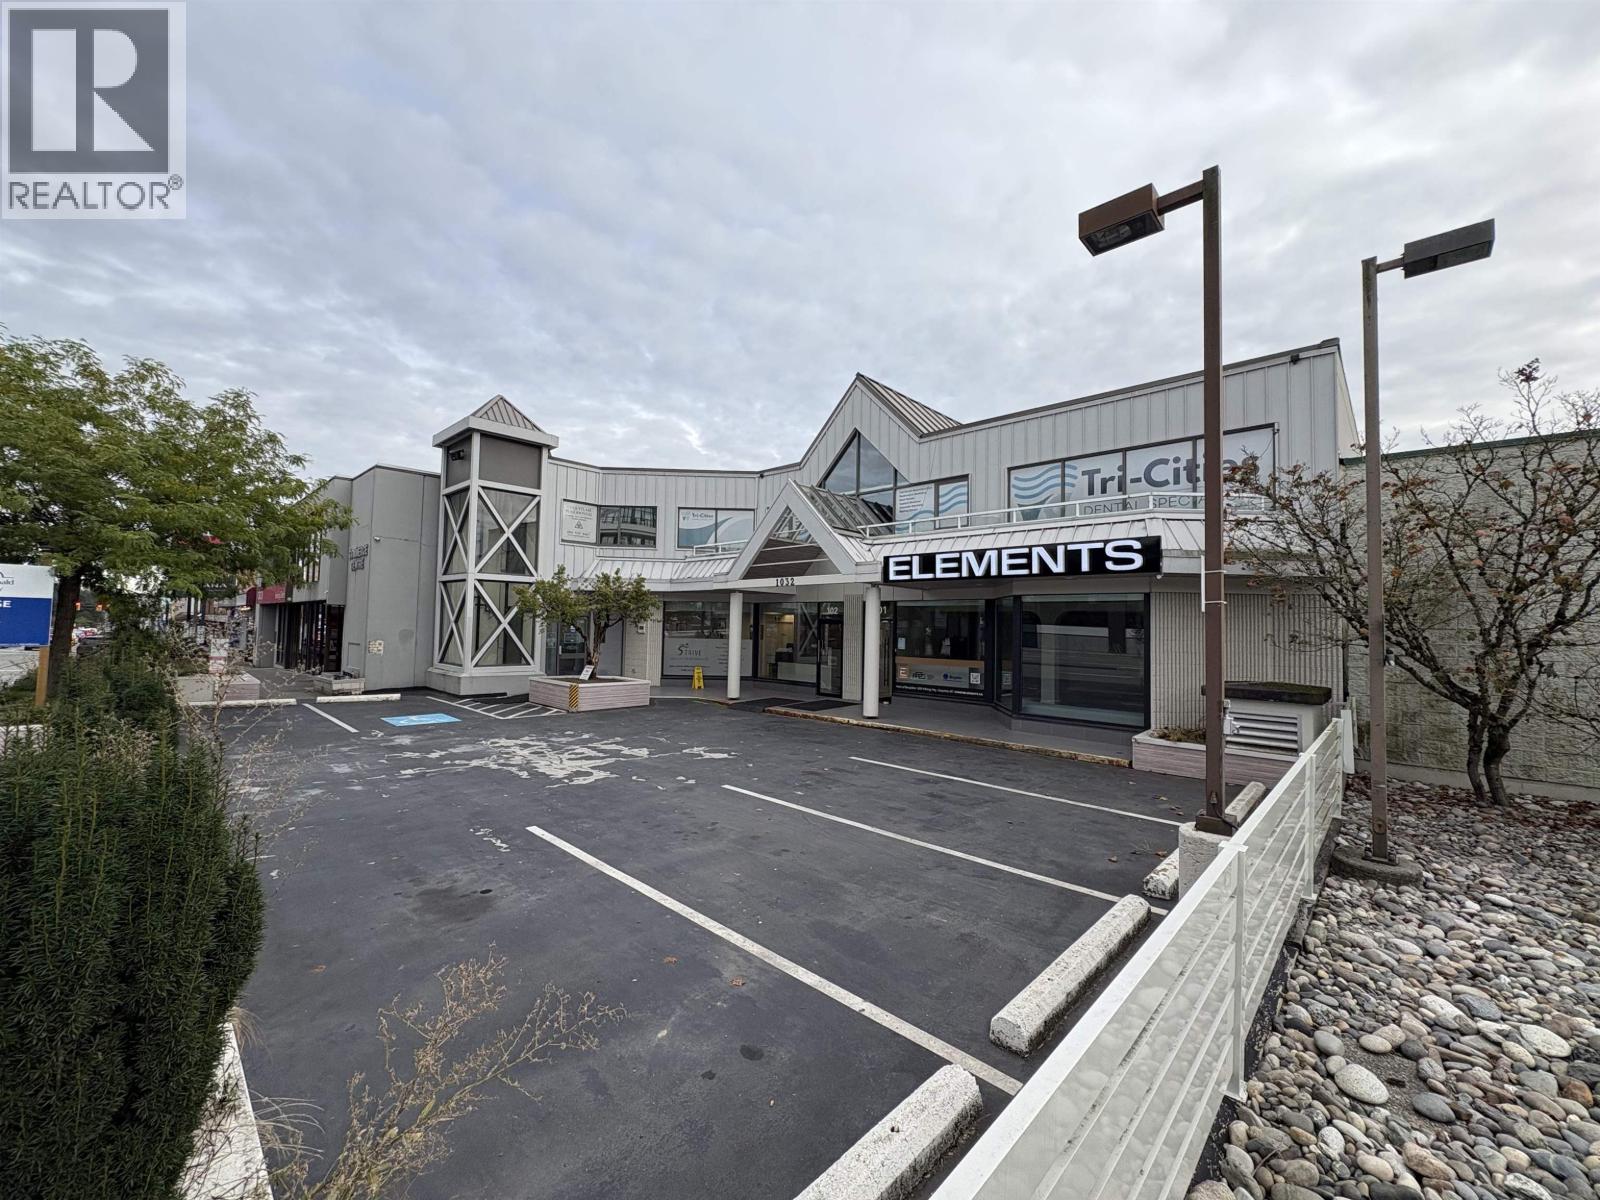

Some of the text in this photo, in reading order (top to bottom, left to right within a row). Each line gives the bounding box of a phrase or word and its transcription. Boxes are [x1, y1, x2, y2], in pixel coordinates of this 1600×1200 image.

[1081, 455, 1260, 496] Tri-Cites
[888, 539, 1144, 581] ELEMENTS
[775, 577, 795, 587] 1032
[826, 606, 839, 614] 102
